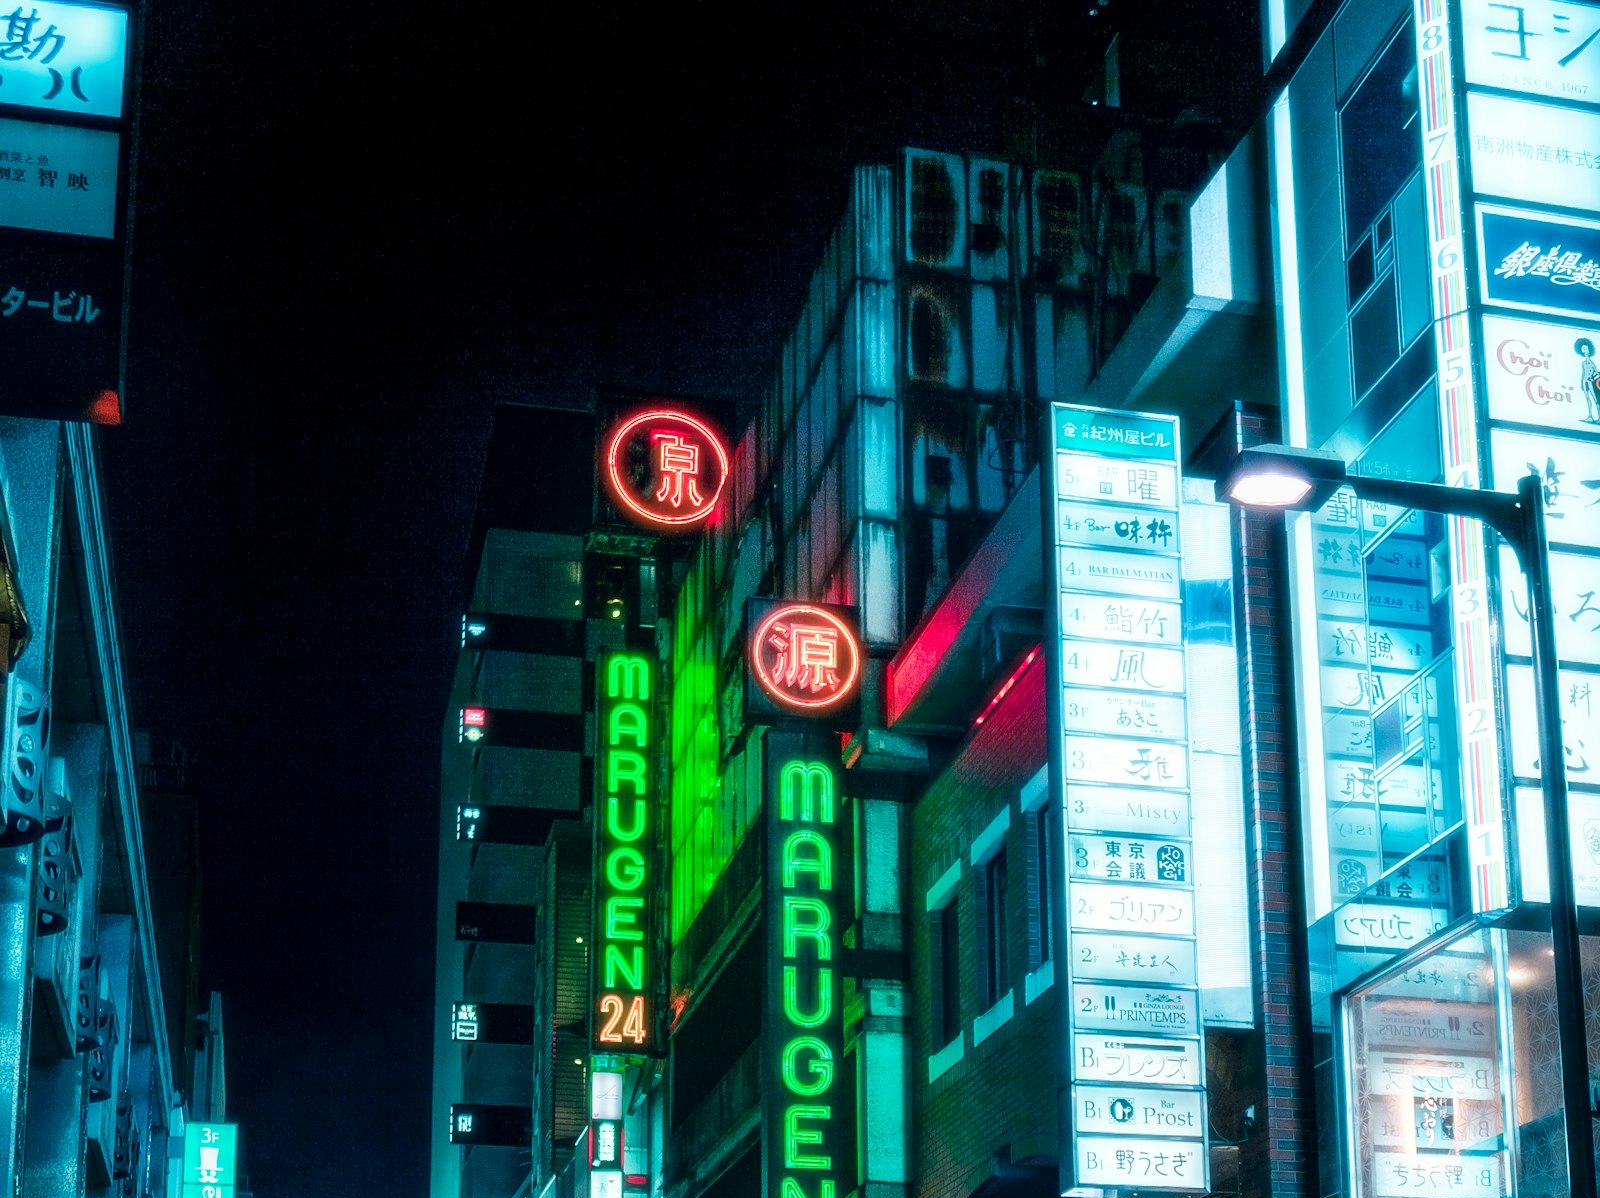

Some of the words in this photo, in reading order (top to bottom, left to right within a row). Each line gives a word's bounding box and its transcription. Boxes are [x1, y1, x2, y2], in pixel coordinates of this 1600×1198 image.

[1422, 25, 1444, 52] 8
[1502, 72, 1553, 90] SINCE
[1560, 82, 1590, 95] 1967
[1428, 132, 1456, 163] 7
[1437, 243, 1459, 270] 6
[1445, 357, 1464, 384] 5
[1090, 425, 1171, 448] 紀州屋ビル
[1098, 466, 1119, 478] BAR
[1127, 469, 1161, 501] 曜
[1084, 517, 1111, 532] Bar
[1088, 564, 1110, 575] BAR
[1112, 567, 1174, 581] DALMATIAN
[1459, 588, 1480, 615] 3
[1104, 604, 1168, 639] 鮨竹
[769, 622, 838, 694] 源
[1110, 649, 1168, 689] 風
[1116, 707, 1159, 729] あきこ
[1469, 708, 1489, 736] 2
[1126, 801, 1182, 824] Misty
[1104, 840, 1145, 859] 東京
[1477, 831, 1493, 857] 1
[1105, 860, 1146, 880] 会議
[1119, 1009, 1187, 1024] PRINTEMPS
[1161, 1003, 1184, 1011] LOUNGE
[599, 994, 647, 1045] 24
[1160, 1099, 1176, 1109] Bar
[1144, 1106, 1195, 1127] Prost
[201, 1127, 220, 1144] 3F
[1116, 1150, 1193, 1177] 野うさぎ
